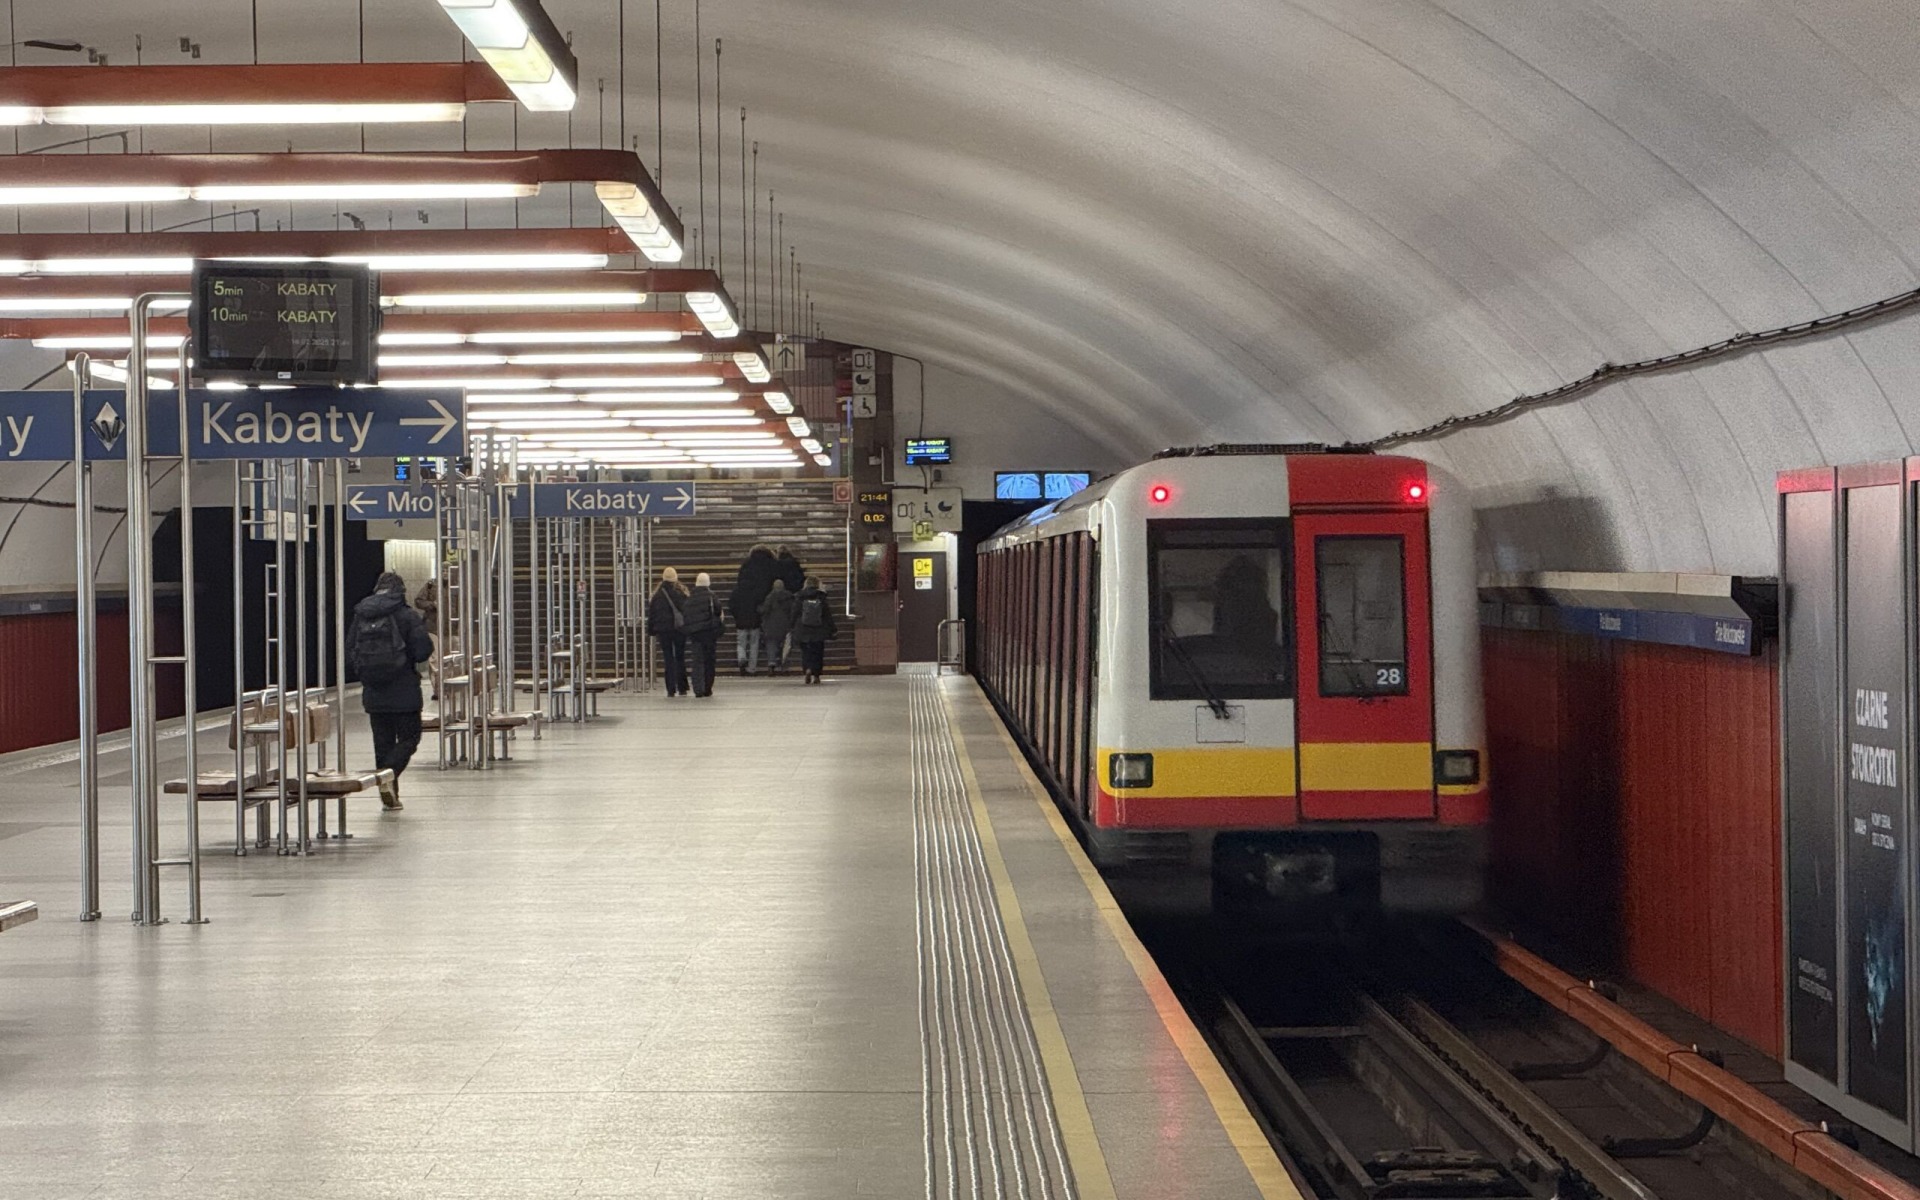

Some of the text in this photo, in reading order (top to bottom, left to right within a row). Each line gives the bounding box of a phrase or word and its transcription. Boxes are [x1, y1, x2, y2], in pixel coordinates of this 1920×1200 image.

[278, 283, 337, 296] KABATY
[278, 310, 337, 323] KABATY
[0, 416, 34, 457] y
[203, 401, 374, 453] Kabaty
[566, 489, 650, 514] Kabaty
[860, 494, 888, 502] 21:44
[1376, 668, 1401, 685] 28
[1855, 688, 1888, 730] CZARNE
[1851, 743, 1897, 787] STOKROTKI
